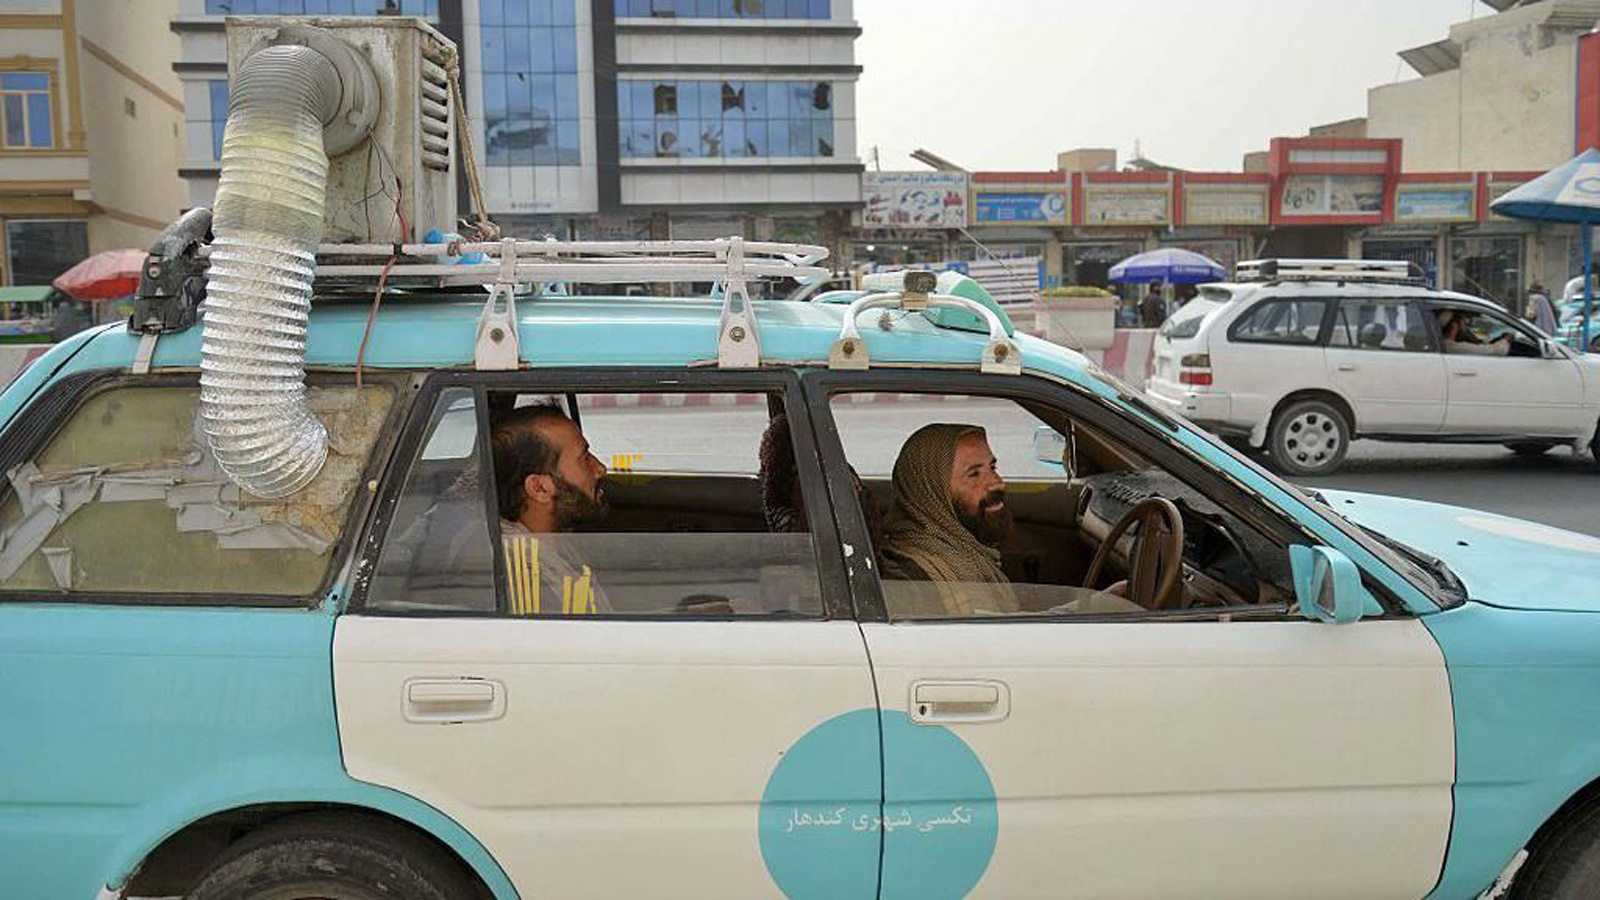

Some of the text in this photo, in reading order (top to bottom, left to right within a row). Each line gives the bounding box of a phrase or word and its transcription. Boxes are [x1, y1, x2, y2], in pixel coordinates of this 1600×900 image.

[785, 805, 974, 833] تکسی شهری کندهار
